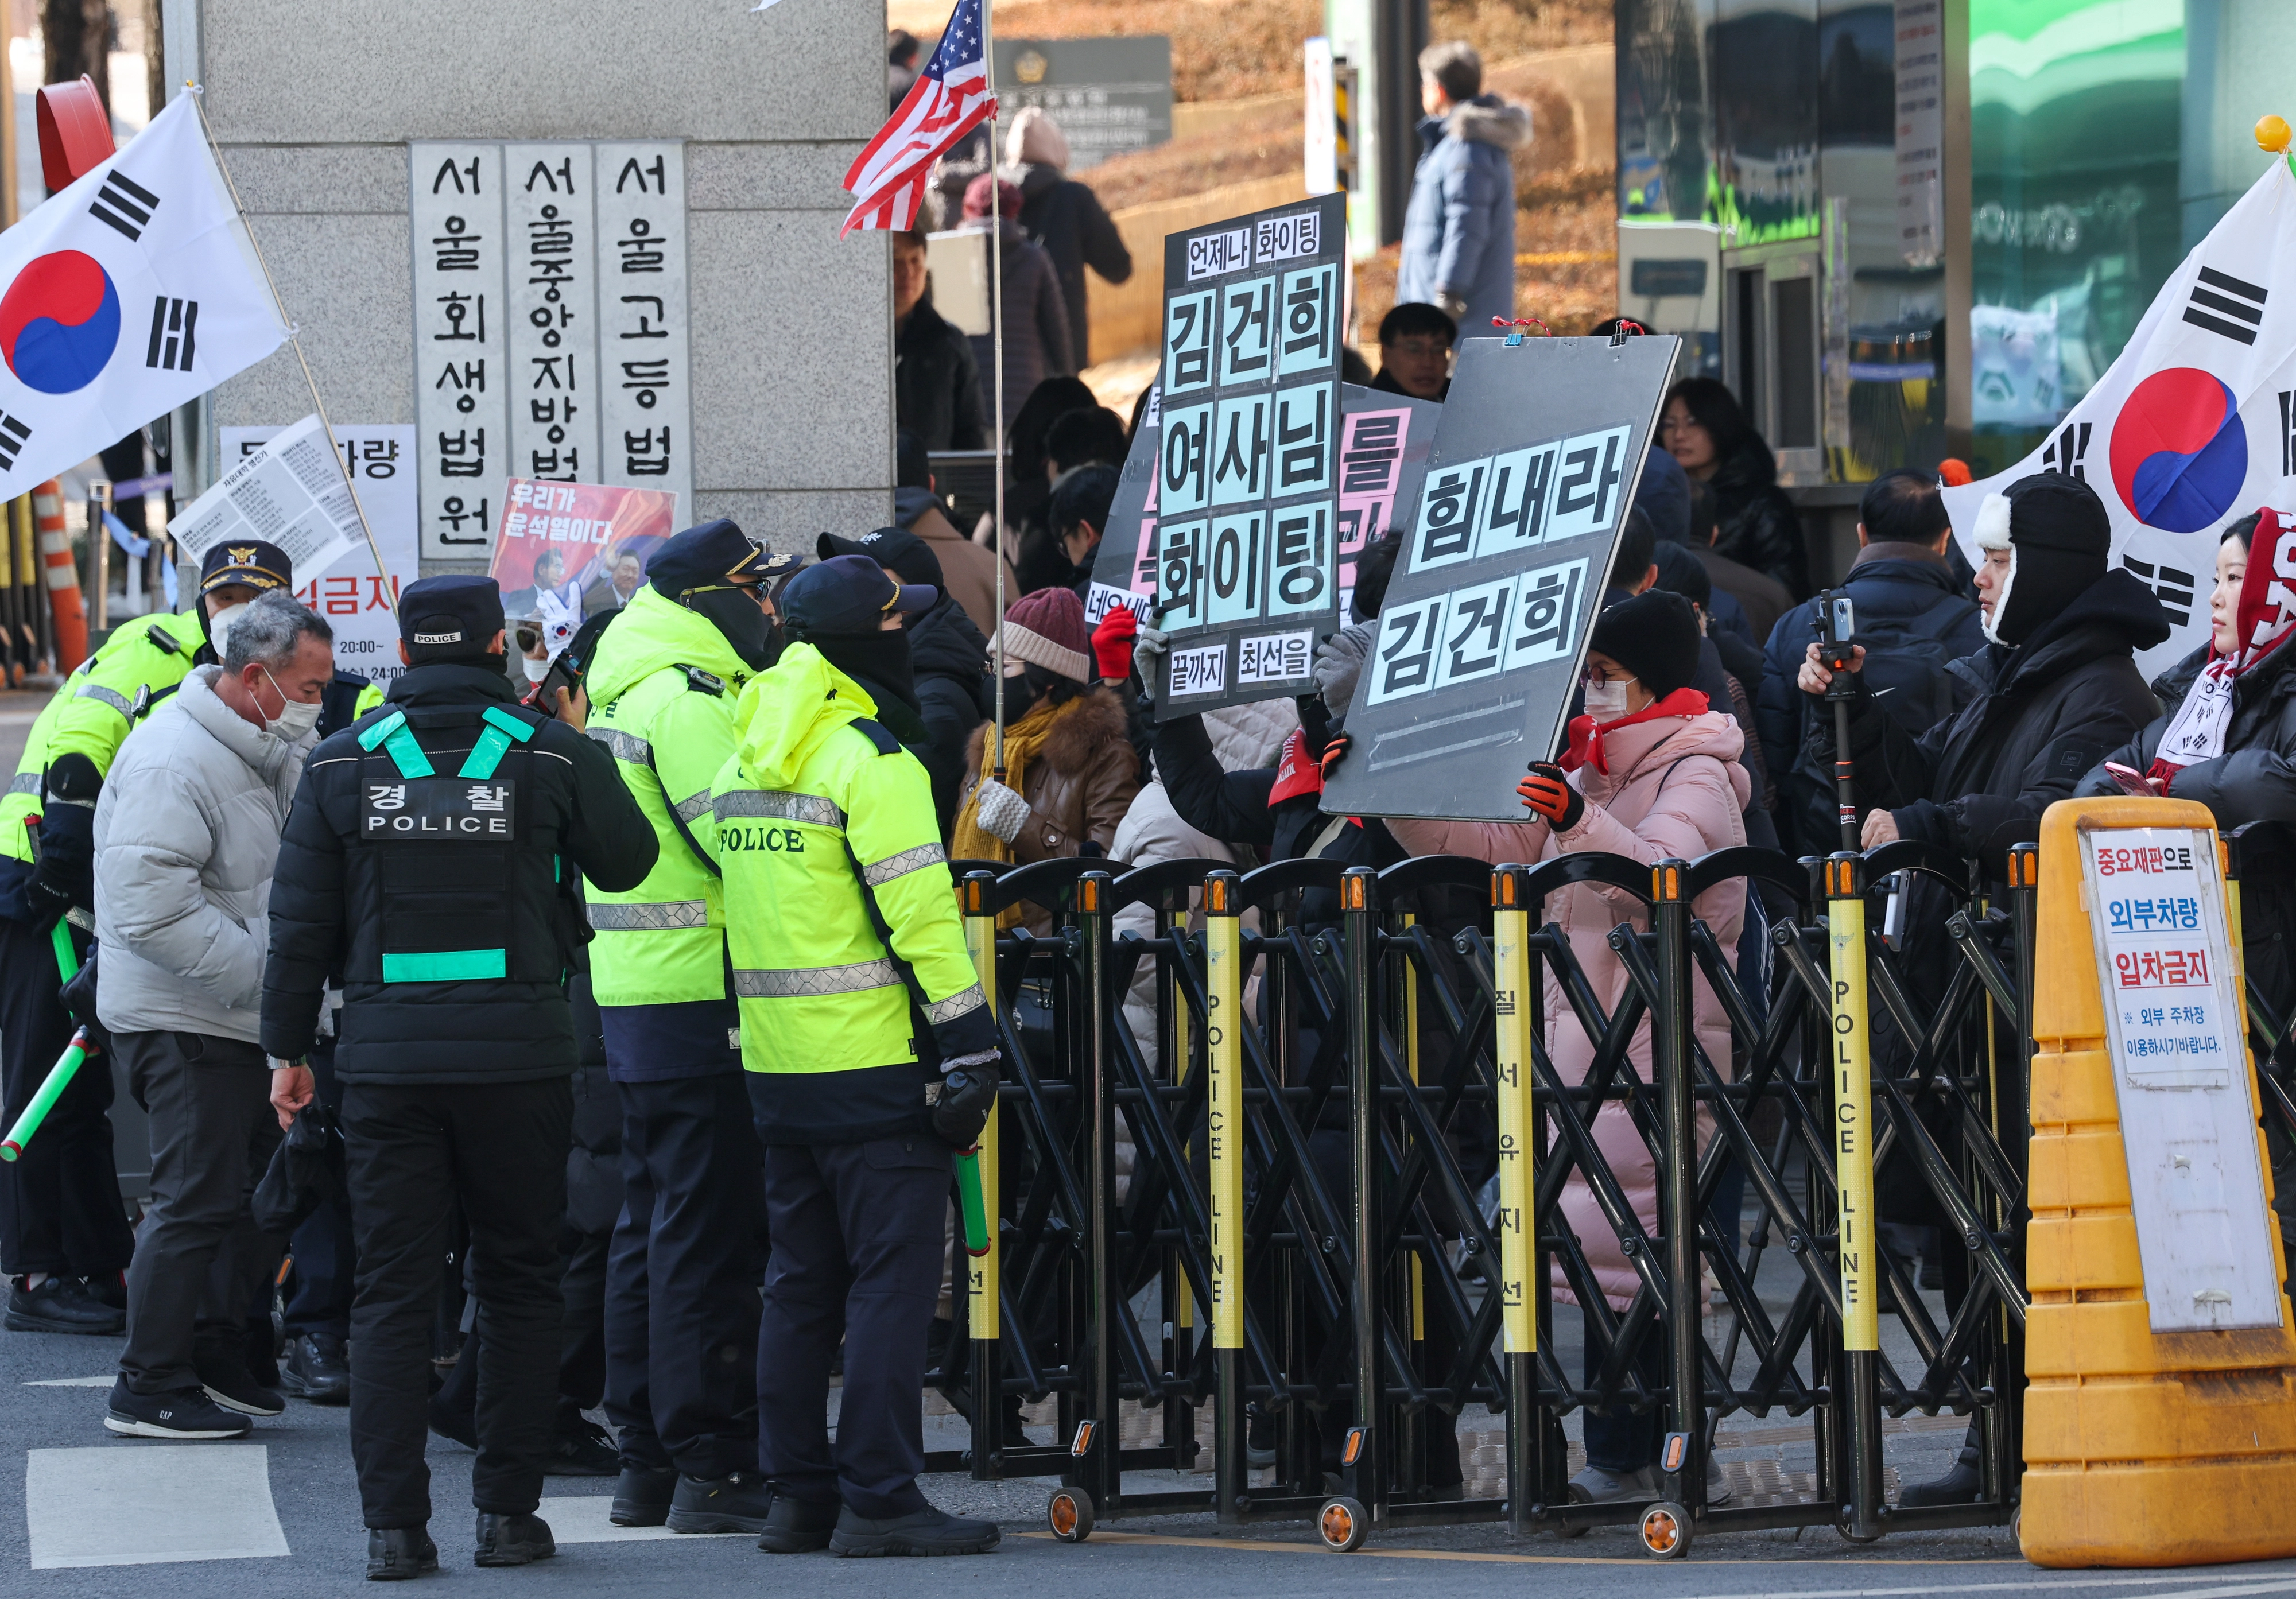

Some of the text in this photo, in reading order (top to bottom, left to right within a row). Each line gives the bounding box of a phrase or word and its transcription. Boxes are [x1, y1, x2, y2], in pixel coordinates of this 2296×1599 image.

[1190, 215, 1317, 275] 언제나 화이팅
[525, 157, 576, 481] 서울중앙지방법
[616, 155, 672, 476] 서울고등법
[1170, 270, 1332, 388] 김건희
[433, 156, 488, 545] 서울회생법원
[1166, 389, 1327, 502] 여사님
[511, 484, 576, 513] 우리가
[1421, 434, 1620, 562] 힘내라
[505, 513, 613, 546] 윤석열이다
[1162, 510, 1326, 618] 화이팅
[340, 641, 384, 653] 20:00~
[418, 634, 456, 643] POLICE
[1382, 567, 1580, 693] 김건희
[1172, 638, 1305, 691] 끝까지 최선을
[369, 816, 507, 833] POLICE
[719, 828, 804, 852] POLICE
[2098, 847, 2193, 876] 중요재판으로
[2109, 897, 2198, 930] 외부차량
[2116, 949, 2209, 986] 입차금지
[2141, 1008, 2165, 1026] 외부
[2170, 1006, 2204, 1025] 주차장
[2127, 1035, 2221, 1057] 이용하시기바랍니다.
[1208, 995, 1224, 1303] POLICE LINE
[1833, 981, 1859, 1305] POLICE LINE
[159, 1410, 173, 1420] GAP
